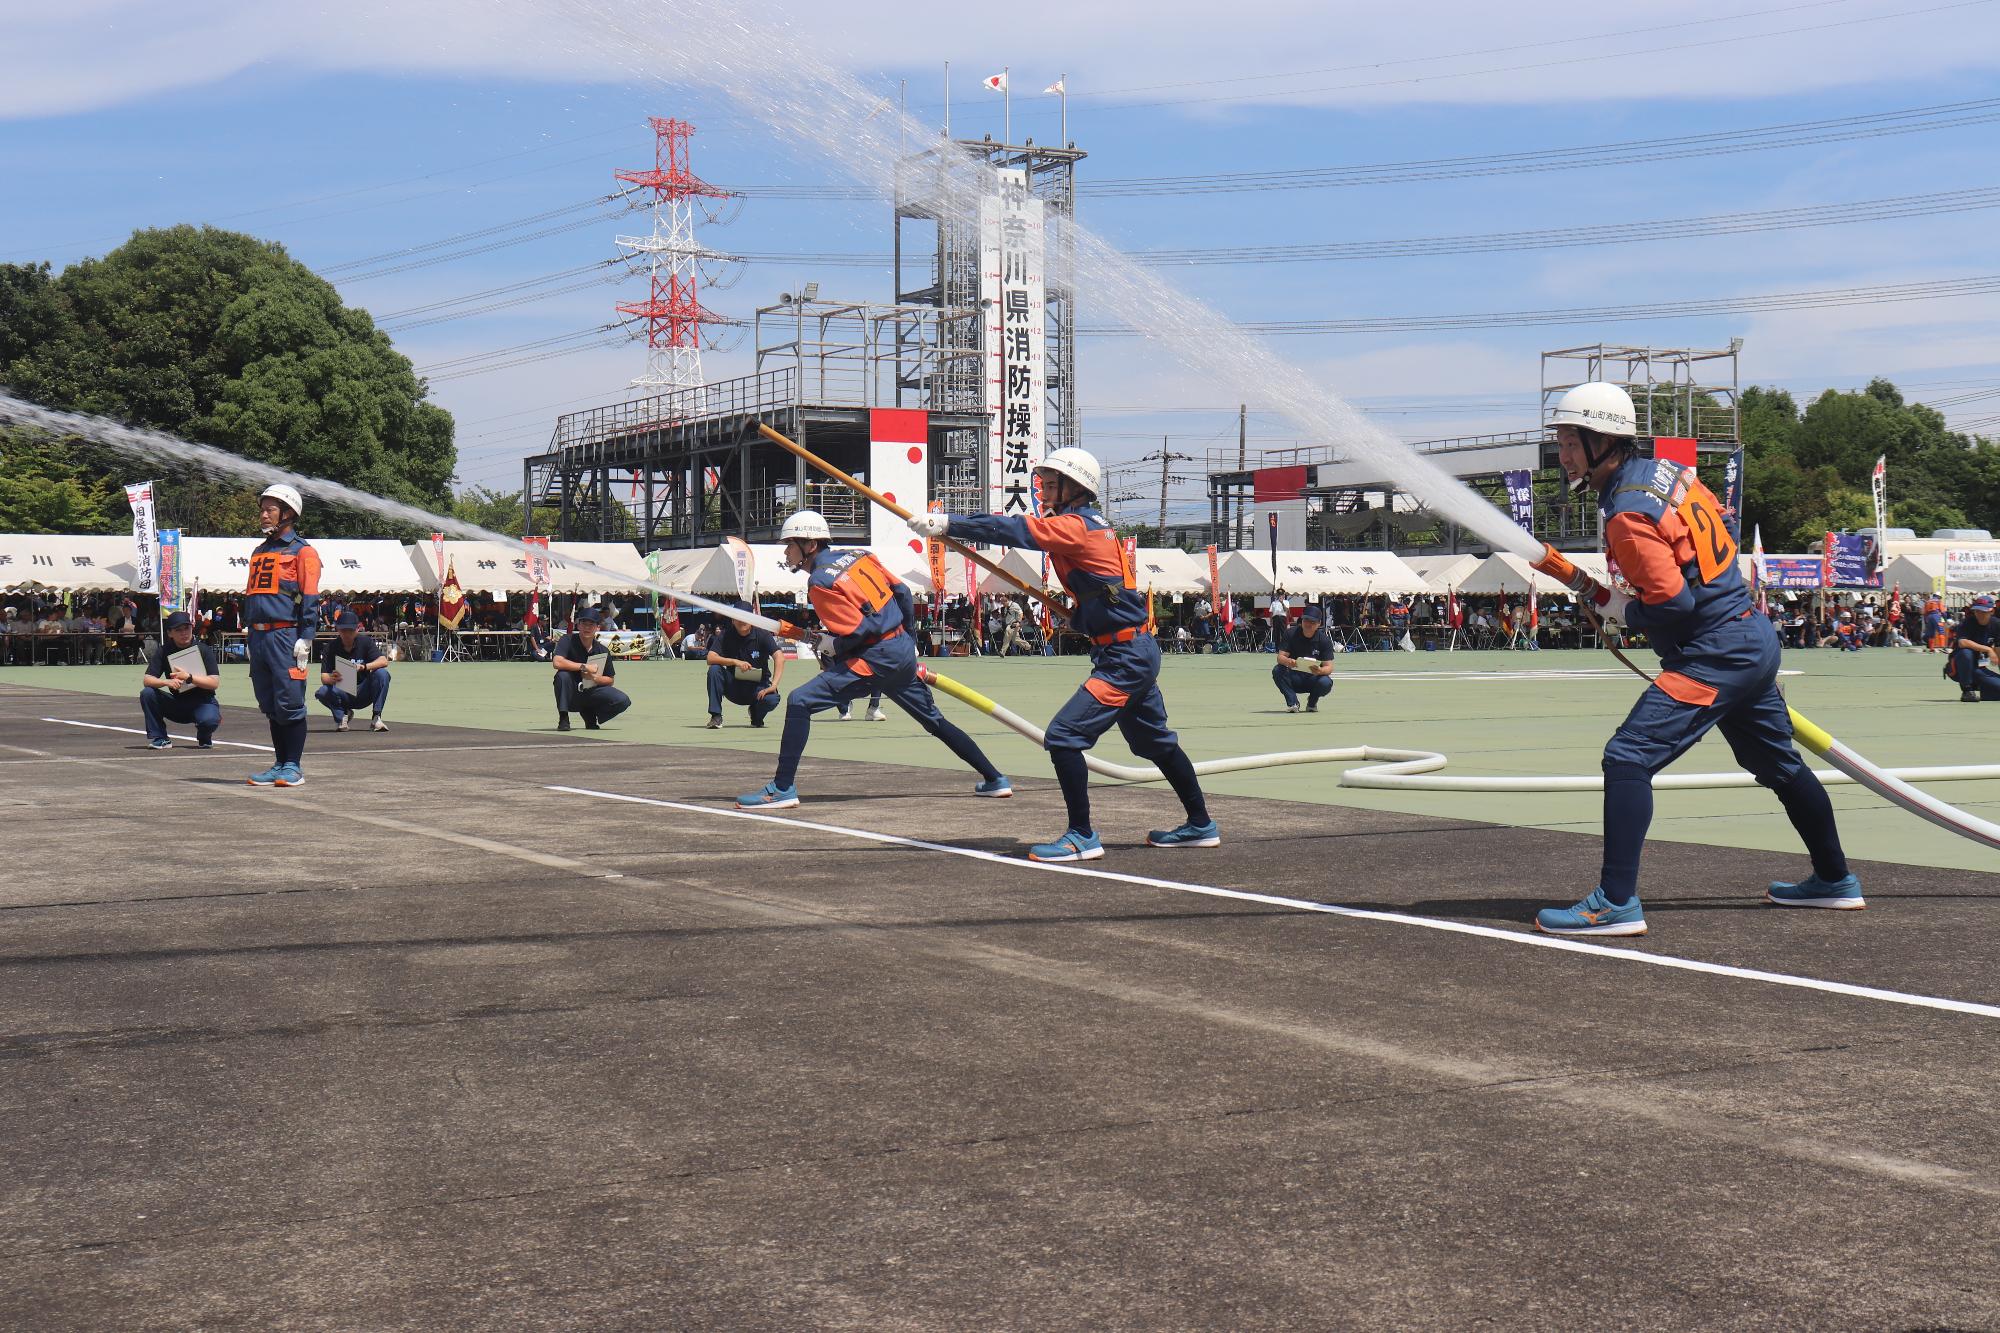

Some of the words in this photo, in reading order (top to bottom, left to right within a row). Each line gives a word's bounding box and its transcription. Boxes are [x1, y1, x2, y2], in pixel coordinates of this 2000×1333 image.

[135, 506, 152, 589] 相模原市消防団
[1691, 501, 1730, 567] 2
[251, 556, 276, 589] 指
[858, 567, 887, 600] 1
[1287, 564, 1379, 575] 神奈川県
